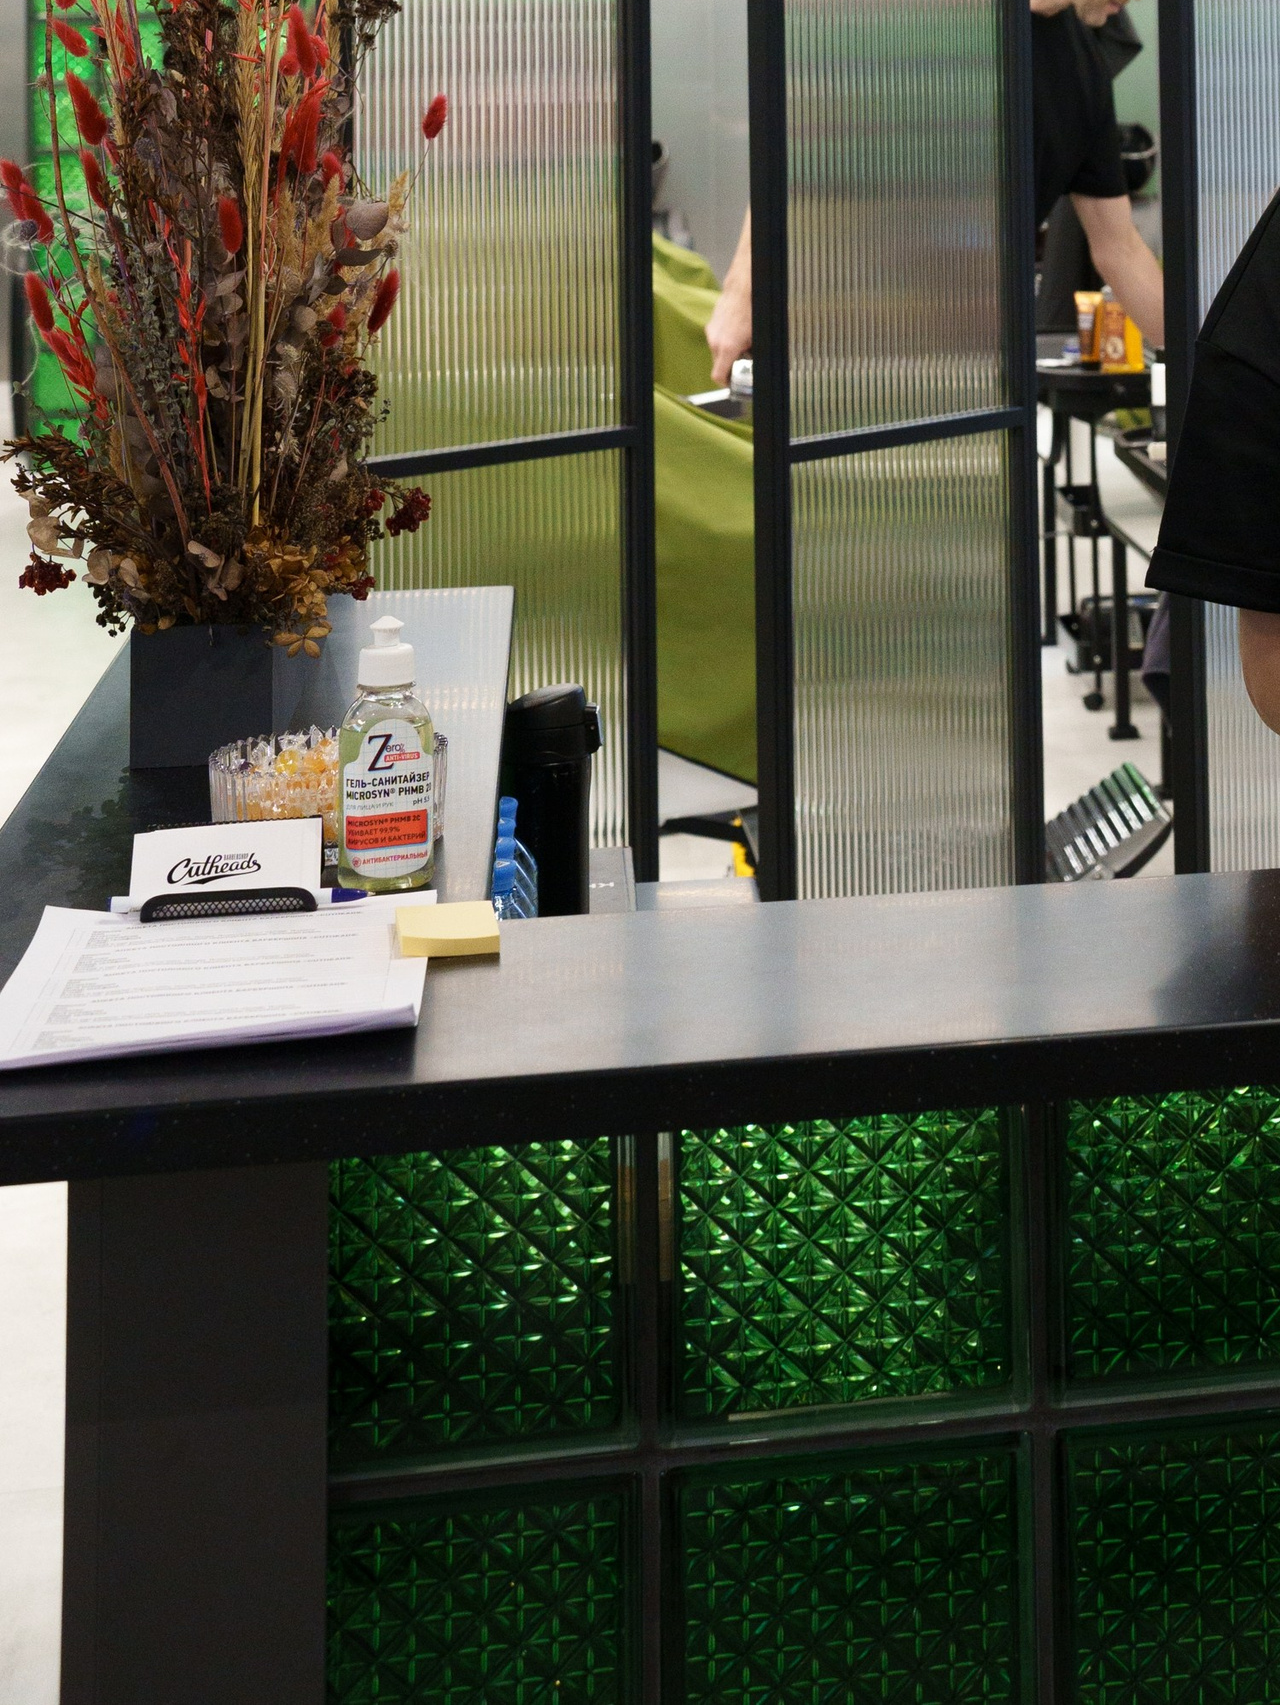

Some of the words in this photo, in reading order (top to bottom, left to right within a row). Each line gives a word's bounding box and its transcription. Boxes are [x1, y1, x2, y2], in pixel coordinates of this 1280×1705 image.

[385, 753, 419, 762] ANTI-VIRUS
[346, 771, 430, 789] ГЕЛЬ-САНИТАЙЗЕР
[398, 785, 424, 797] PHMB
[356, 802, 376, 811] ЛИЦА
[412, 798, 423, 806] pH
[390, 815, 412, 824] PHMB
[349, 827, 378, 837] УБИВАЕТ
[380, 836, 387, 844] И
[388, 830, 426, 843] БАКТЕРИЙ
[223, 853, 249, 861] BARBERSHOP
[362, 850, 428, 865] АНТИБАКТЕРИАЛЬНЫЙ
[167, 852, 261, 885] Cutheads
